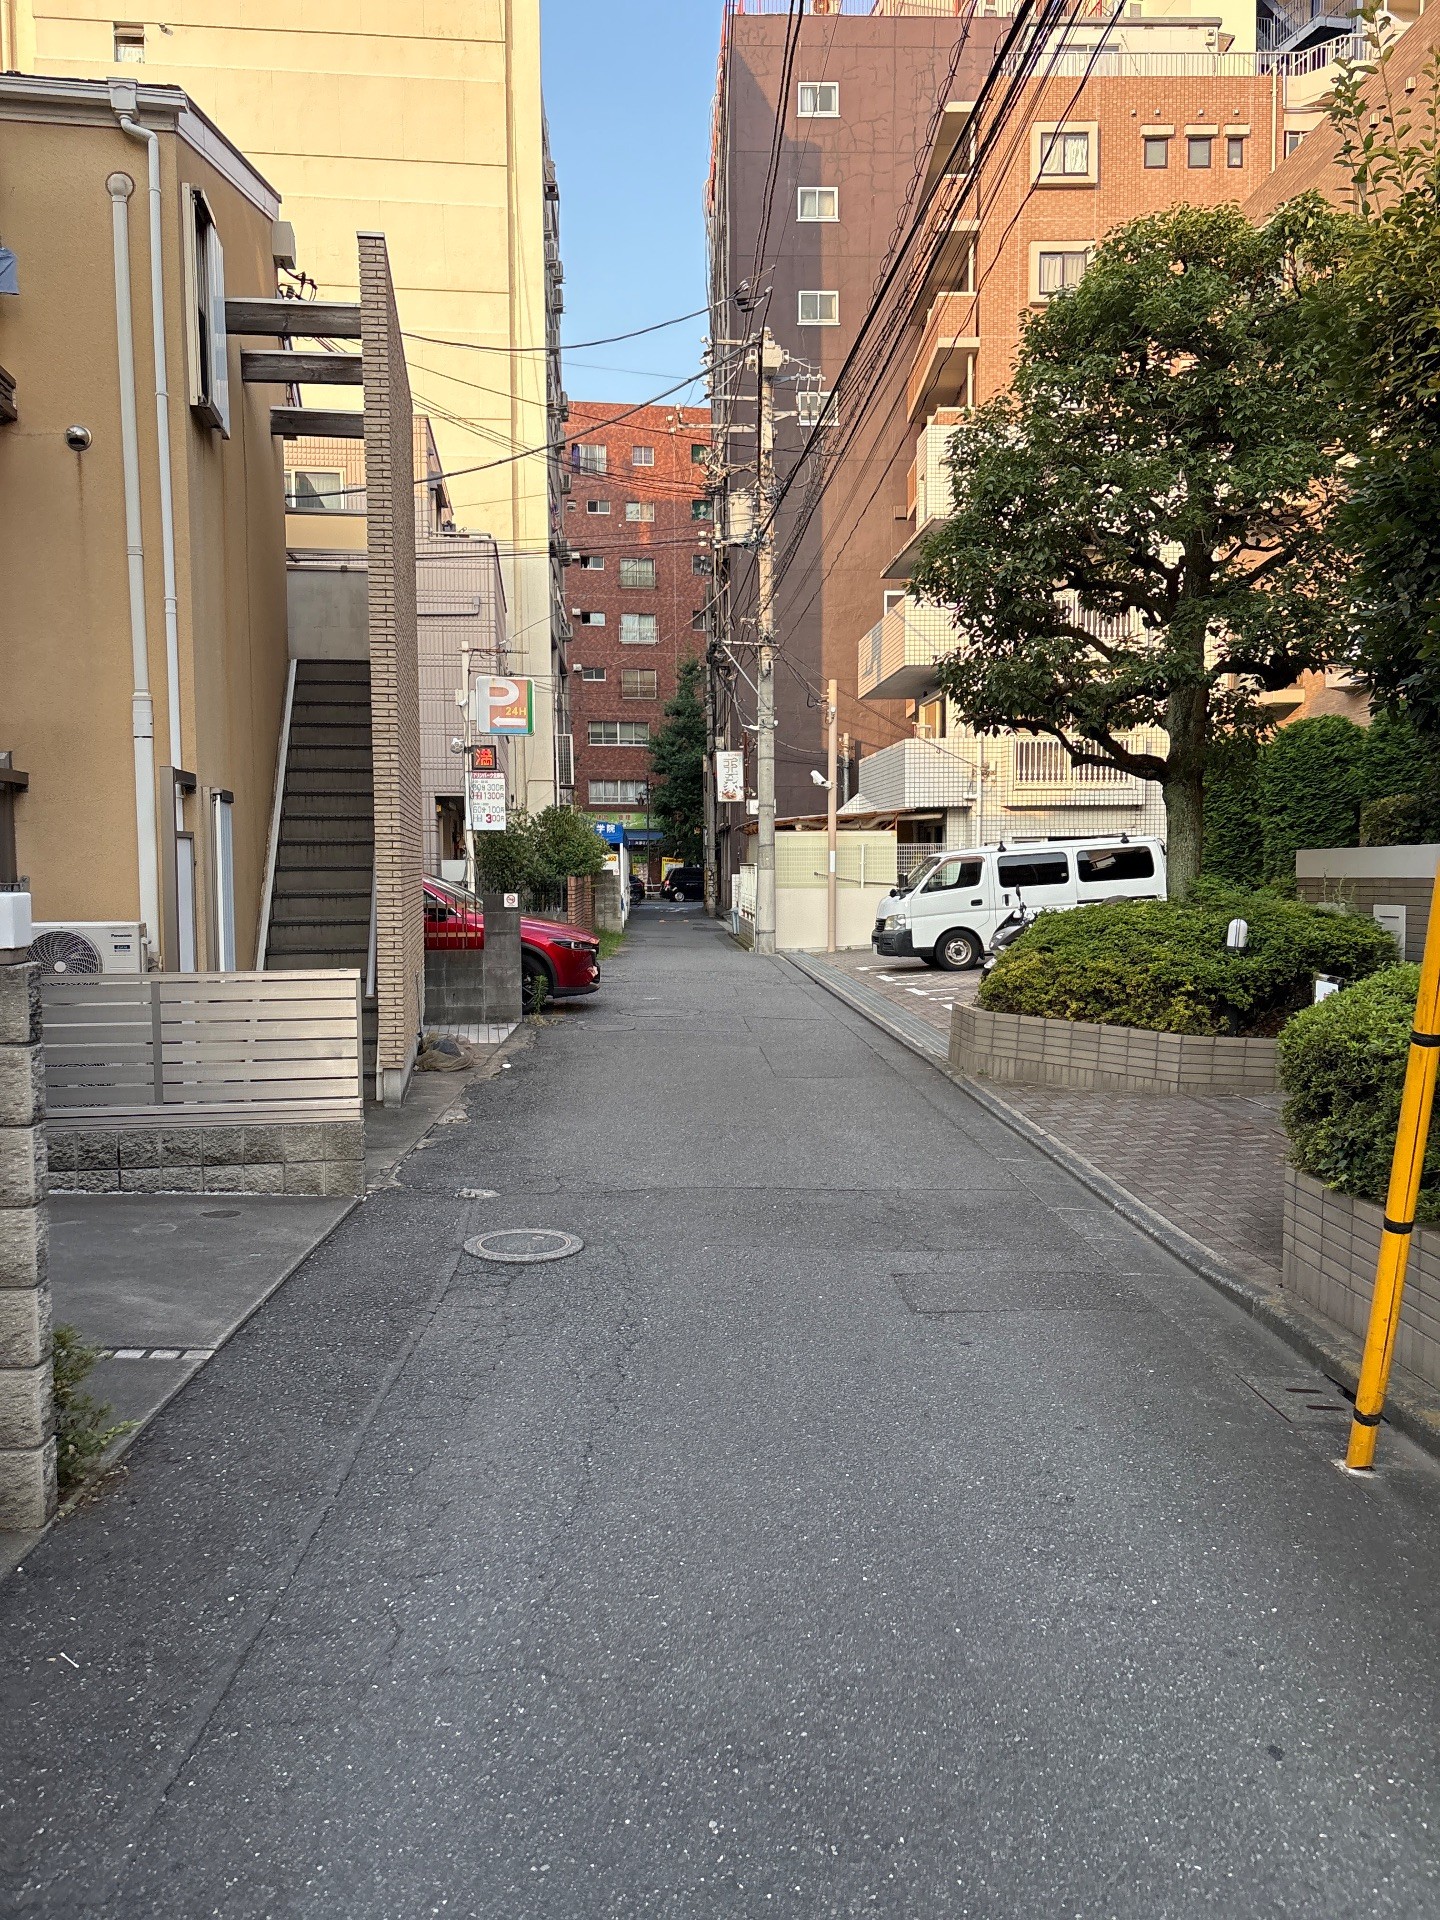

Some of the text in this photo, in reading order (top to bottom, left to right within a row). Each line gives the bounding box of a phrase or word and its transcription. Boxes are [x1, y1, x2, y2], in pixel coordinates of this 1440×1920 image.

[478, 678, 520, 733] P
[506, 706, 527, 716] 24H
[476, 748, 492, 765] 満
